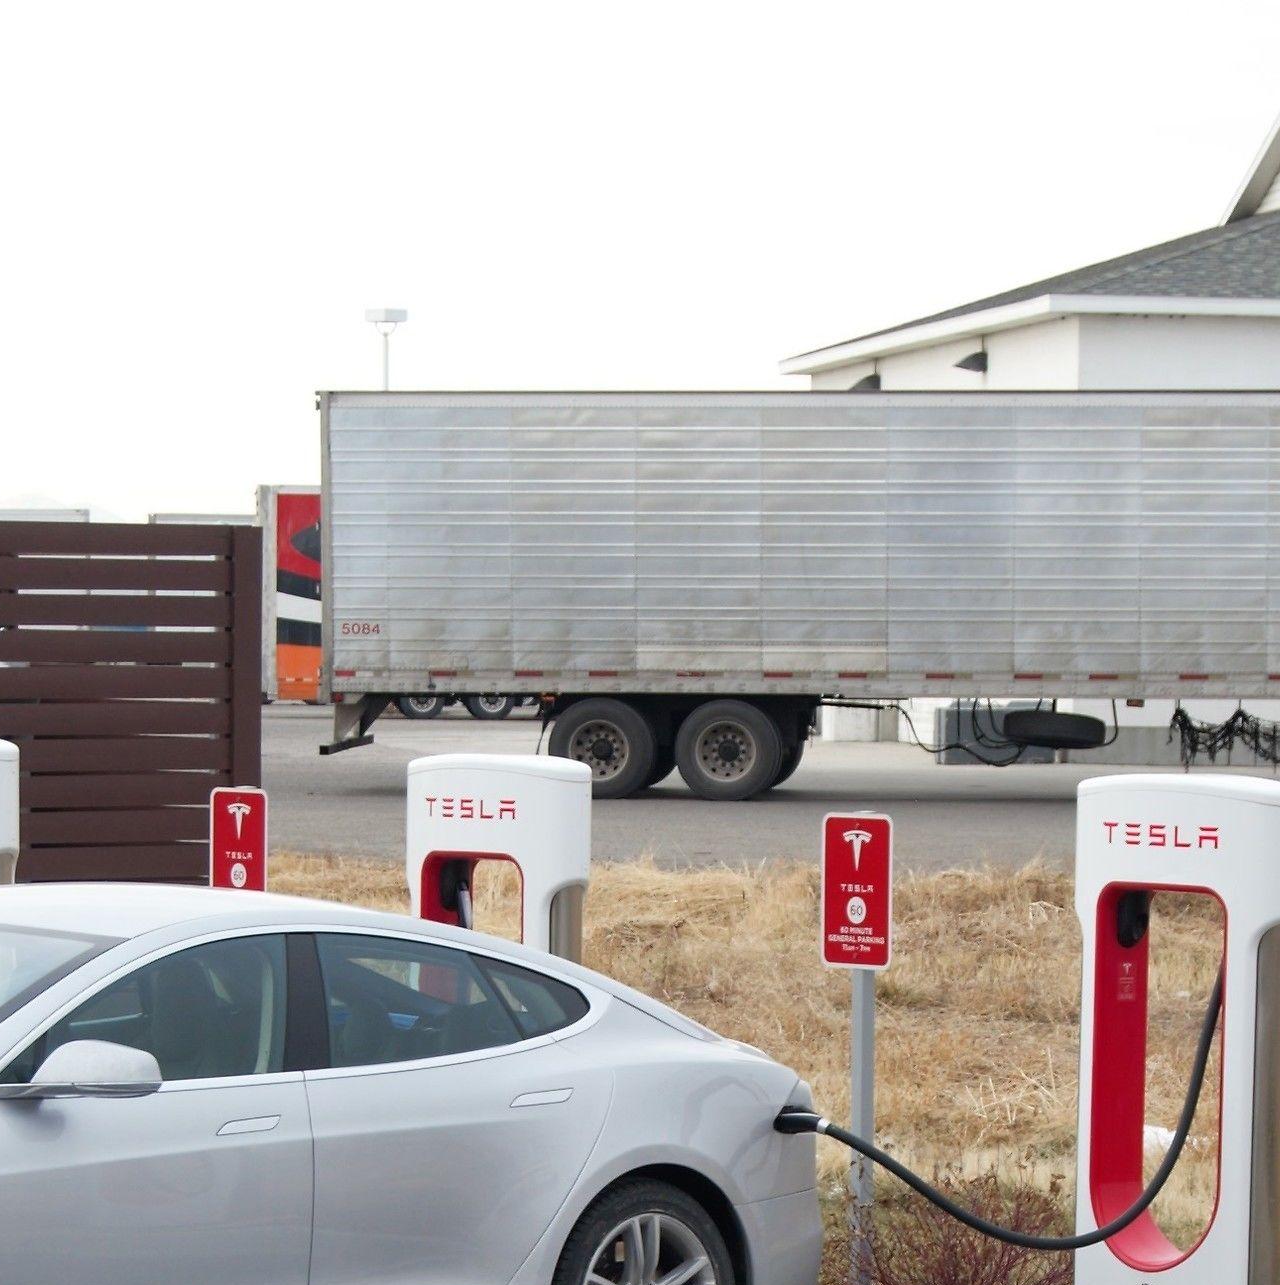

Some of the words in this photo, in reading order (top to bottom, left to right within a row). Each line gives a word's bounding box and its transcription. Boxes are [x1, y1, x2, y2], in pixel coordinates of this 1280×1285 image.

[342, 623, 380, 635] 5084
[425, 797, 516, 820] TESLA
[1103, 821, 1219, 849] TESLA
[225, 851, 253, 860] TESLA
[840, 883, 874, 893] TESLA
[850, 904, 863, 915] 60
